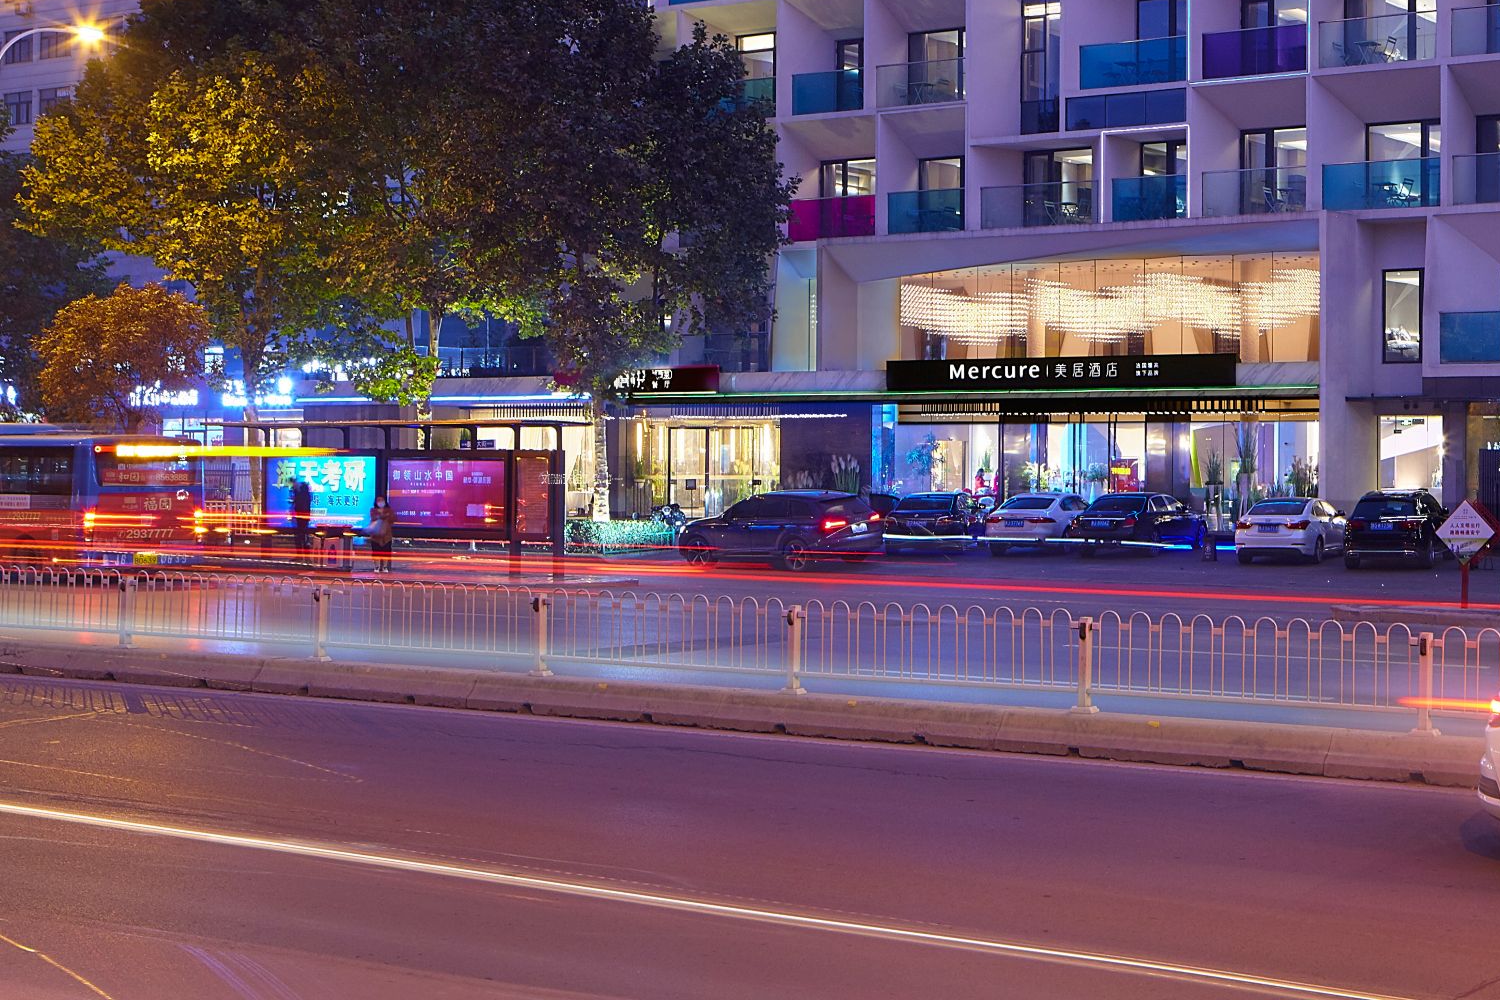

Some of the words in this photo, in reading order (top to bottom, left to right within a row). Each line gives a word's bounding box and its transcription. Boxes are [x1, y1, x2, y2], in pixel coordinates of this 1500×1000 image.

[949, 363, 1040, 380] Mercure
[1055, 362, 1118, 378] 美居酒店
[126, 529, 174, 539] 2937777
